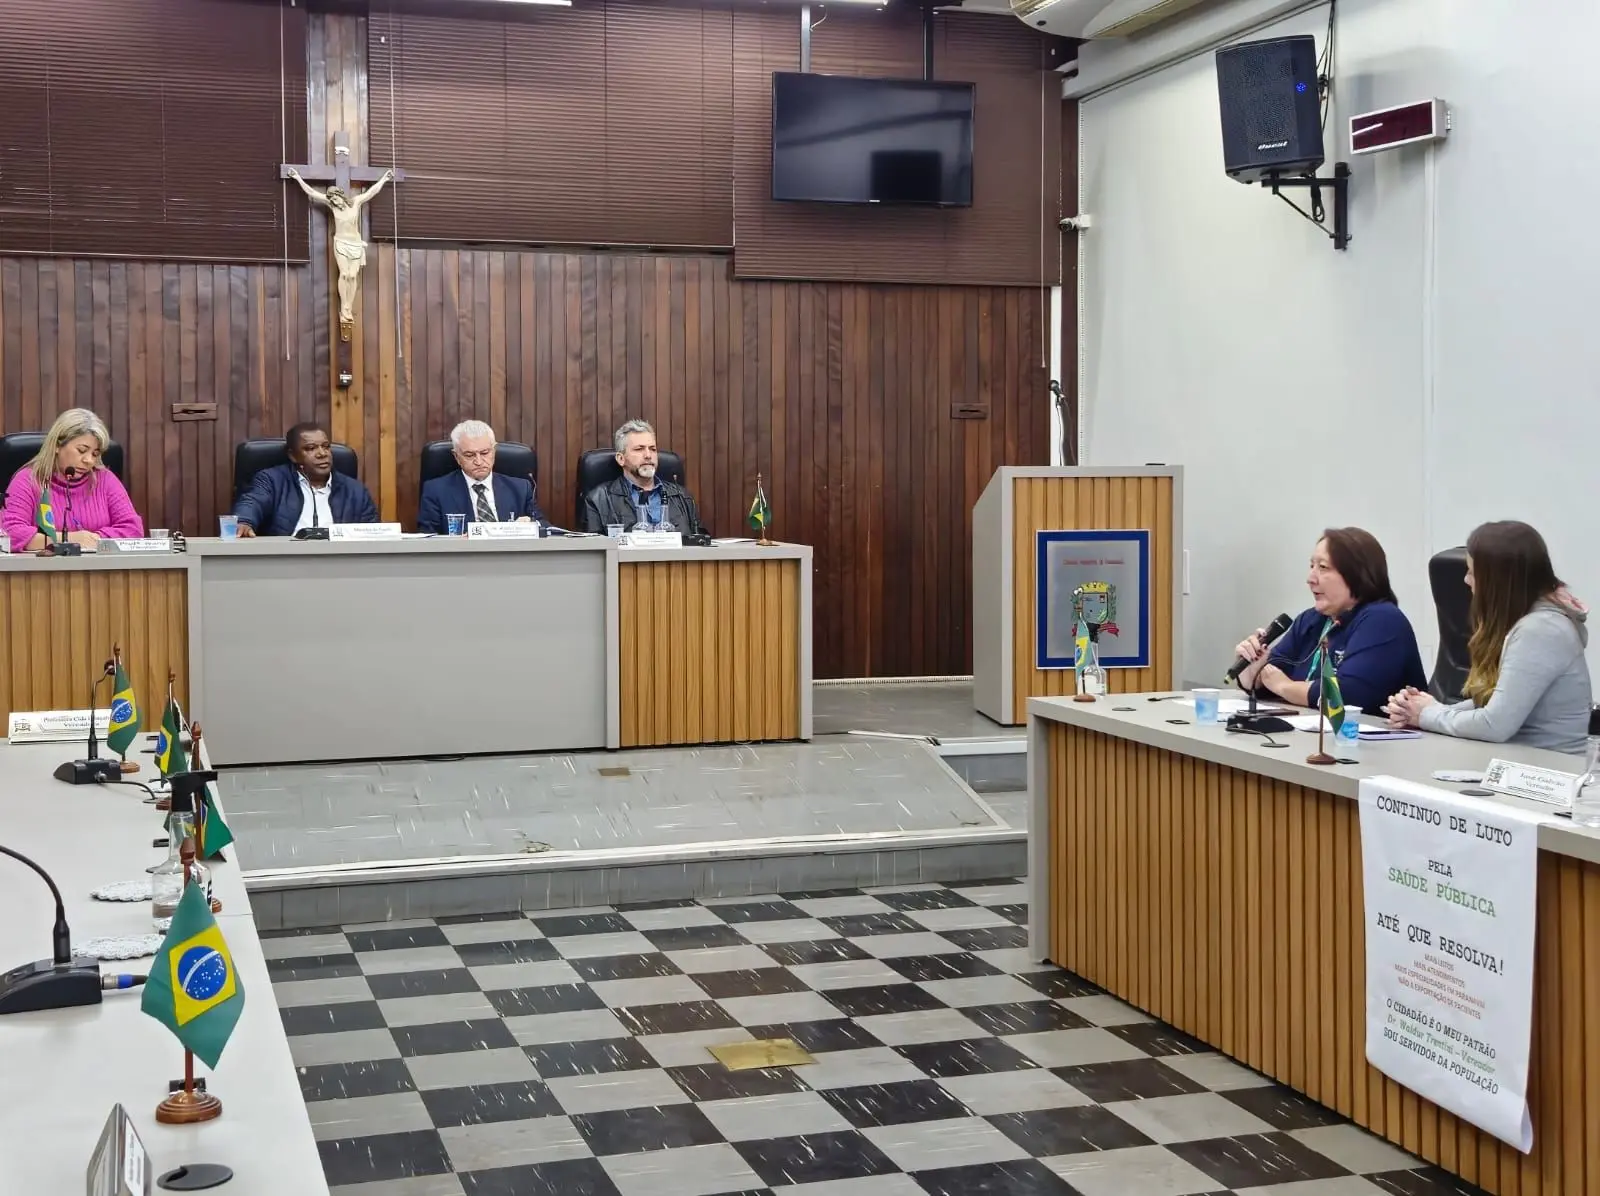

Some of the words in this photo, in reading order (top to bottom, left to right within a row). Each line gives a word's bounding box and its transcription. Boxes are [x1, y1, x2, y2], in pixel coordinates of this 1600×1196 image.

[1376, 796, 1441, 826] CONTINUO
[1450, 816, 1466, 834] DE
[1476, 822, 1512, 846] LUTO
[1388, 866, 1428, 893] SAÚDE
[1436, 881, 1496, 918] PÚBLICA
[1428, 860, 1452, 878] PELA
[1377, 912, 1400, 933] ATÉ
[1408, 924, 1432, 946] QUE
[1440, 936, 1504, 976] RESOLVA!
[1386, 998, 1392, 1008] O
[1394, 1001, 1428, 1025] CIDADÃO
[1428, 1016, 1435, 1028] É
[1436, 1022, 1442, 1032] O
[1444, 1025, 1462, 1042] MEU
[1462, 1034, 1496, 1059] PATRÃO
[1384, 1026, 1398, 1042] SOU
[1398, 1036, 1436, 1062] SERVIDOR
[1437, 1054, 1448, 1068] DA
[1450, 1062, 1498, 1094] POPULAÇÃO
